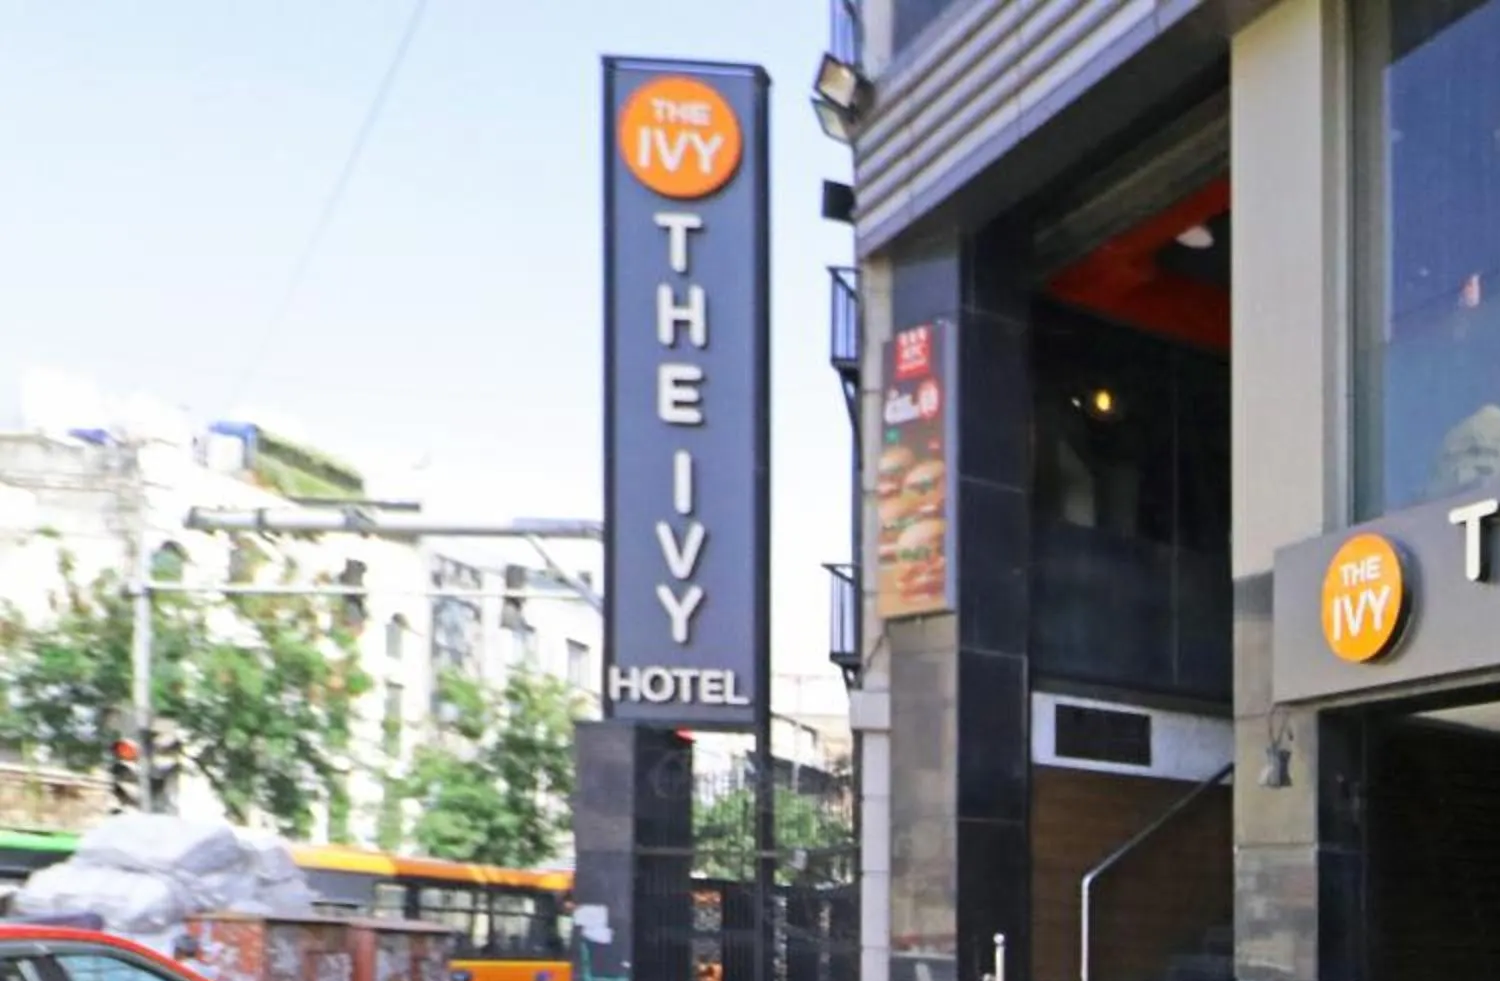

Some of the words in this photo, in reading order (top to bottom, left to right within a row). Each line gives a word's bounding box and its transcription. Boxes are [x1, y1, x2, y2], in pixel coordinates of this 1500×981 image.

[651, 97, 711, 126] THE
[636, 127, 724, 174] IVY
[655, 213, 706, 425] THE
[655, 449, 705, 645] IVY
[1339, 554, 1382, 584] THE
[1332, 585, 1391, 642] IVY
[608, 665, 750, 706] HOTEL
